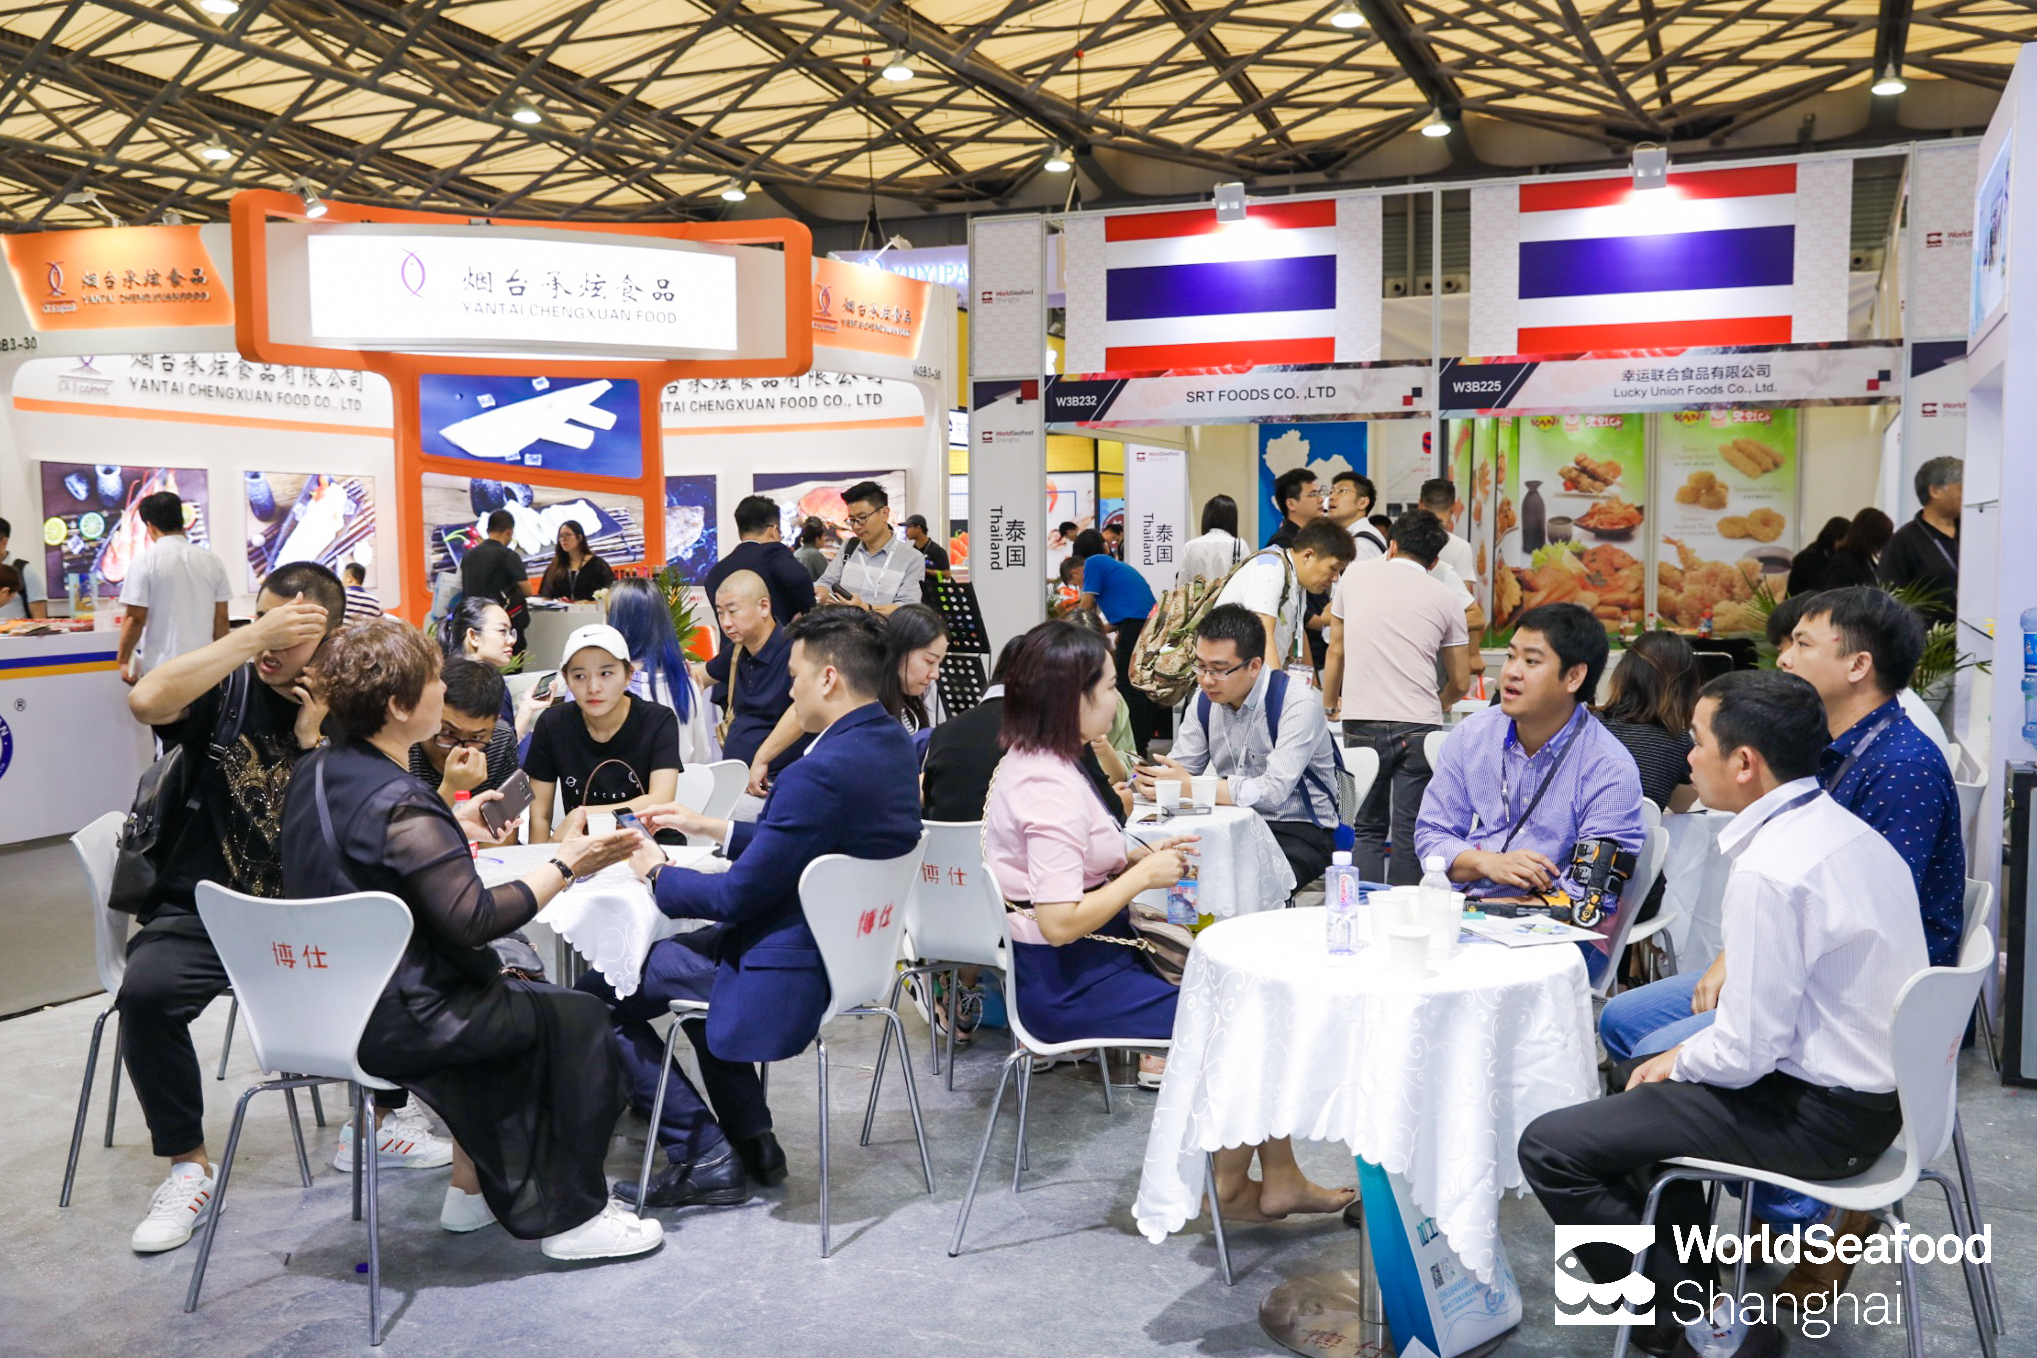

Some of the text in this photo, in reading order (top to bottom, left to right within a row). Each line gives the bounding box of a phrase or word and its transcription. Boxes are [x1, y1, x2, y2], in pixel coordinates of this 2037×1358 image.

[463, 266, 675, 302] 烟台承炫食品
[995, 289, 1033, 297] WorldSeafood
[463, 302, 677, 324] YANTAI CHENGXUAN FOOD
[1621, 364, 1771, 383] 幸运联合食品有限公司
[129, 377, 183, 394] YANTAI
[188, 382, 273, 404] CHENGXUAN
[277, 391, 311, 407] FOOD
[341, 398, 362, 411] LTD
[1186, 390, 1214, 403] SRT
[1218, 388, 1269, 401] FOODS
[1273, 387, 1299, 400] CO.
[1453, 380, 1502, 393] W3B225
[1613, 387, 1647, 399] Lucky
[1651, 385, 1684, 397] Union
[1687, 384, 1724, 396] Foods
[1755, 382, 1778, 393] Ltd.
[690, 398, 775, 413] CHENGXUAN
[780, 396, 818, 409] FOOD
[856, 393, 882, 405] LTD
[1055, 395, 1097, 407] W3B232
[990, 505, 1003, 570] Thailand
[1005, 519, 1026, 567] 泰国
[1143, 512, 1154, 565] Thailand
[1156, 524, 1173, 563] 泰国
[920, 861, 968, 887] 博仕
[272, 941, 329, 969] 博仕
